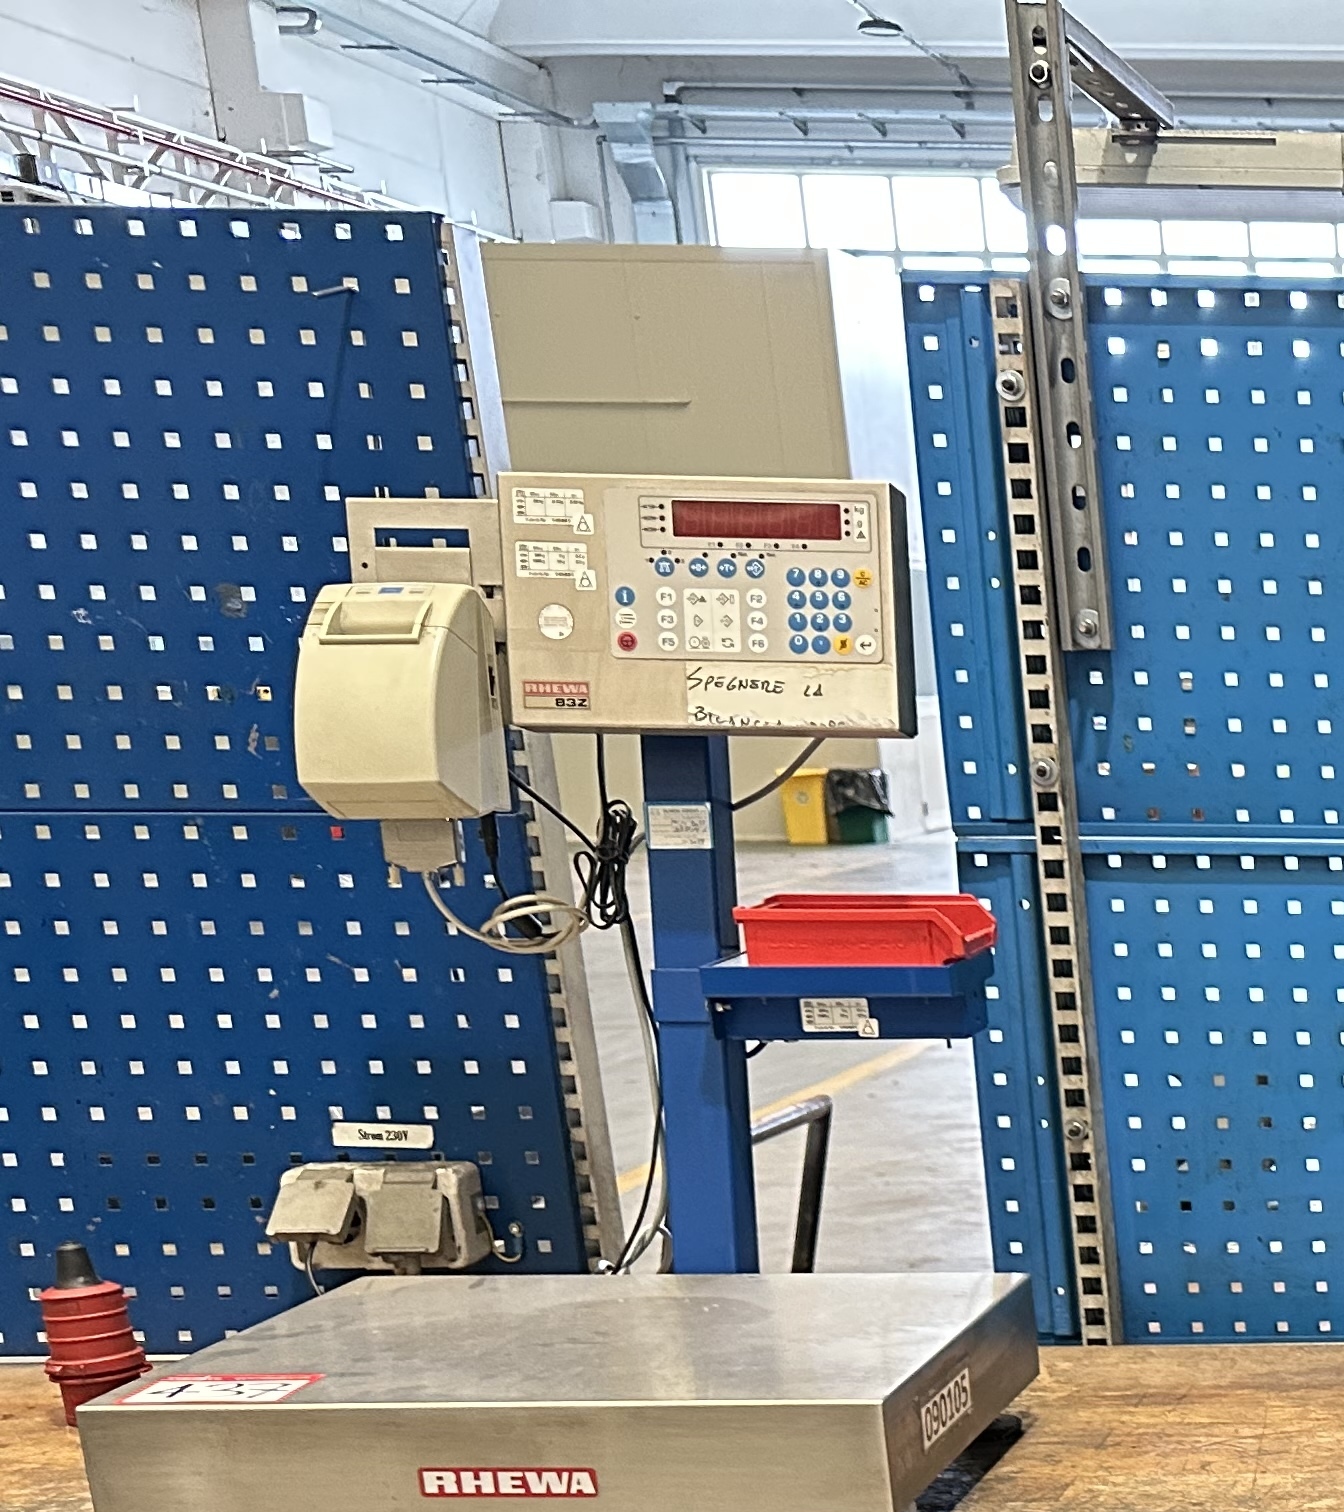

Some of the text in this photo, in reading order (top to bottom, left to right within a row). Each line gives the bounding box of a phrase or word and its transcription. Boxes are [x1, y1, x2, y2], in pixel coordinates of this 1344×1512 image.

[854, 505, 865, 515] kg
[660, 592, 673, 601] F1
[750, 594, 763, 604] F2
[661, 615, 674, 624] F3
[751, 617, 764, 625] F4
[662, 637, 676, 647] F5
[752, 639, 765, 648] F6
[686, 666, 786, 695] SPEGNERE
[524, 683, 588, 694] RHEWA
[384, 1129, 409, 1141] 230V
[924, 1373, 969, 1442] 090105
[422, 1471, 597, 1494] RHEWA
